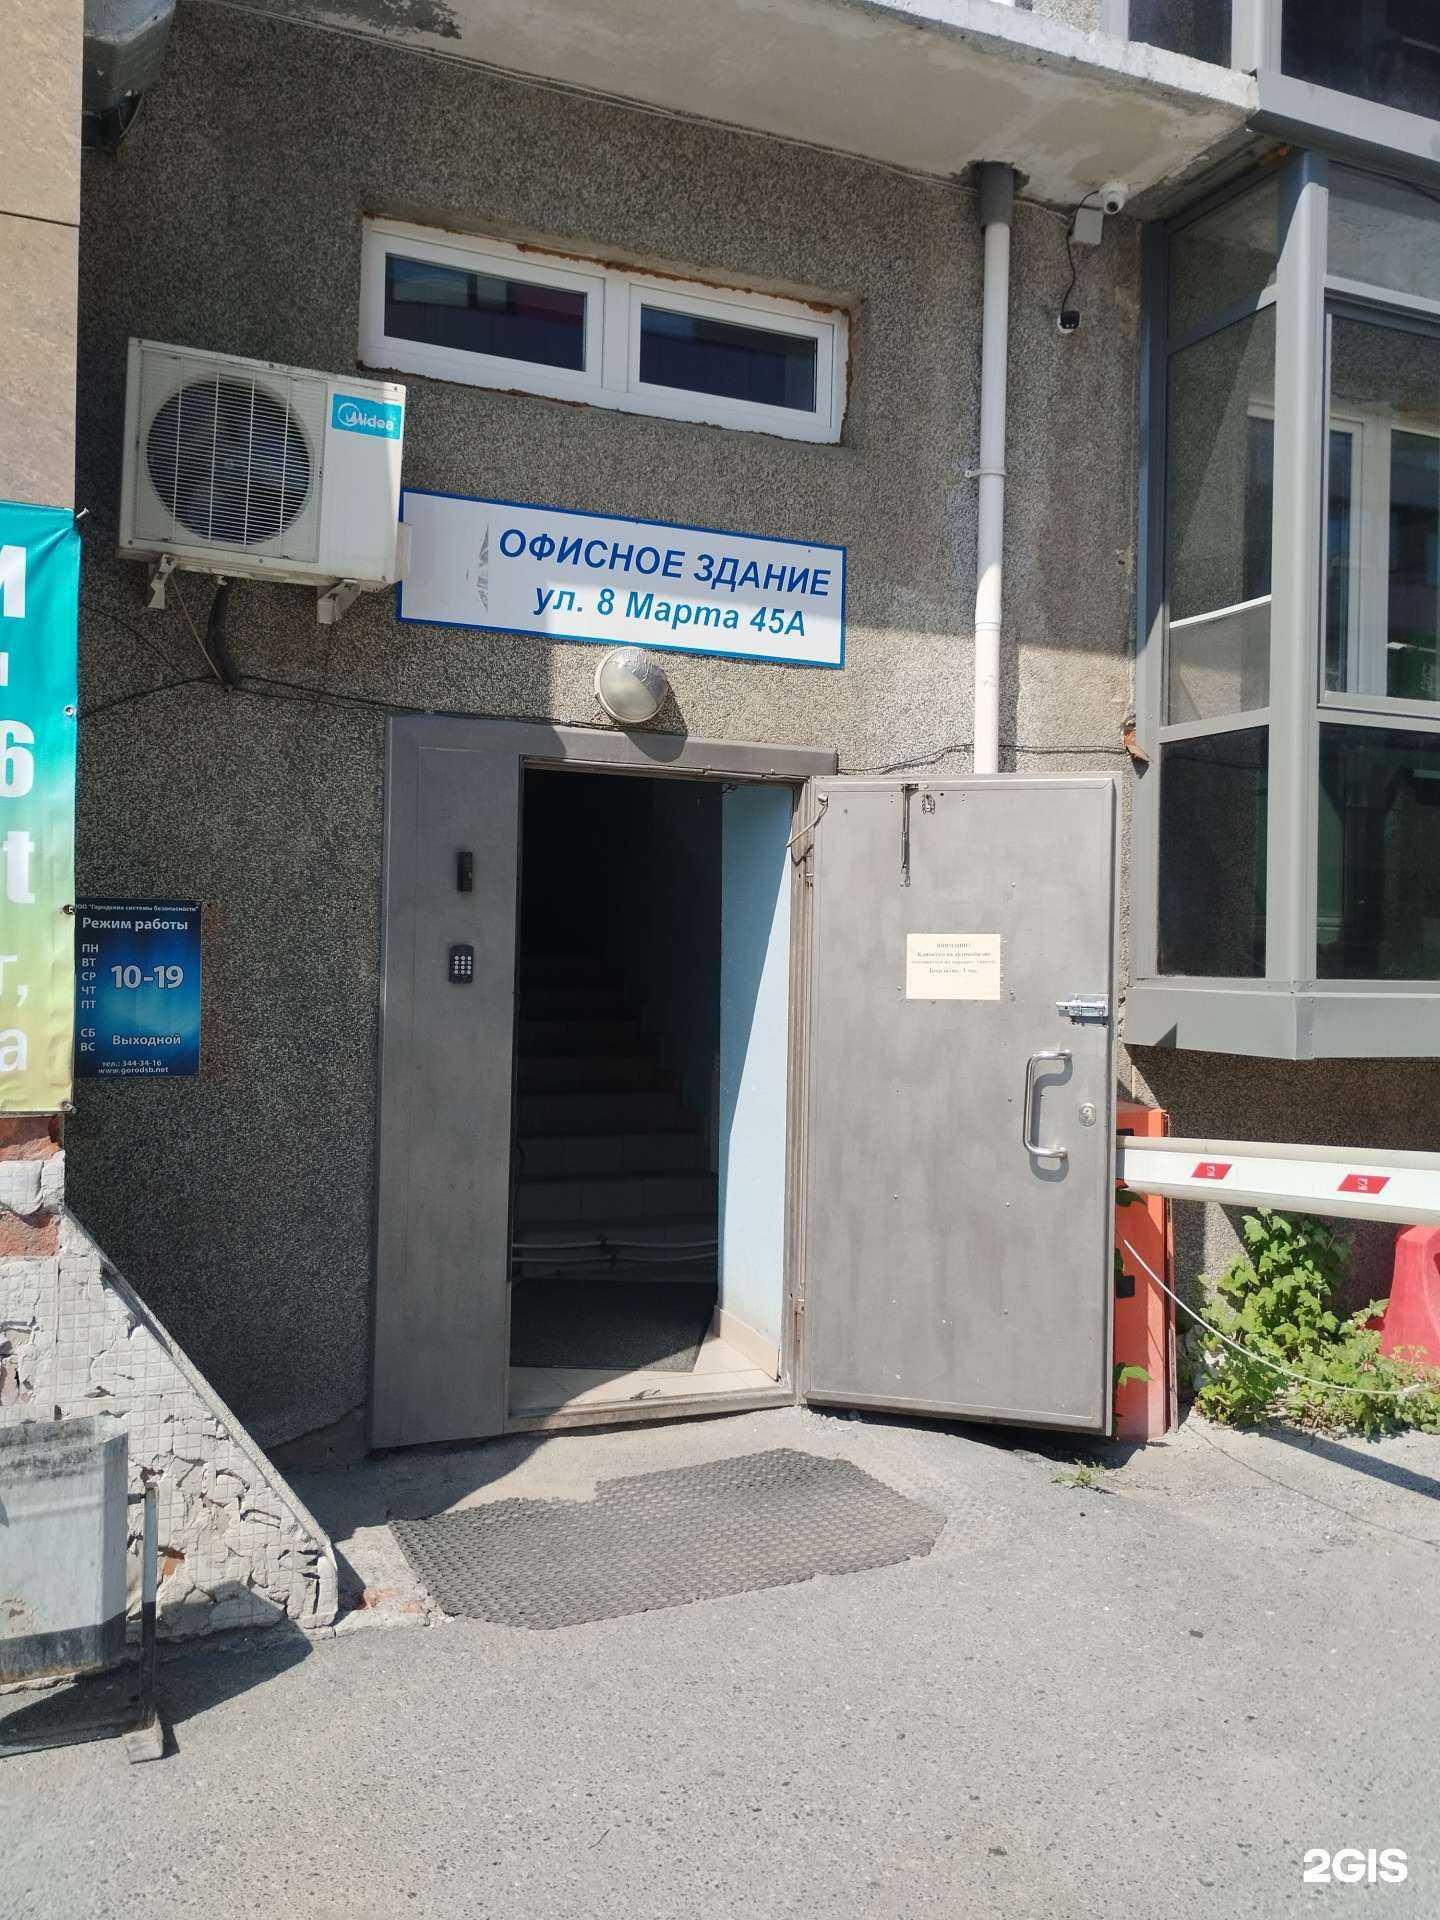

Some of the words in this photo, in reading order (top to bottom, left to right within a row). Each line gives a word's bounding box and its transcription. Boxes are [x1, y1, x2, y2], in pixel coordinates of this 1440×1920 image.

[342, 407, 395, 431] Midea
[500, 528, 685, 578] ОФИСНОЕ
[693, 553, 832, 596] ЗДАНИЕ
[533, 588, 583, 615] ул.
[597, 588, 615, 615] 8
[625, 591, 740, 630] Марта
[750, 606, 805, 636] 45А
[82, 917, 131, 929] Режим
[134, 918, 188, 932] работы
[82, 943, 99, 953] ПН
[82, 957, 97, 967] ВТ
[81, 971, 97, 981] СР
[111, 965, 184, 989] 10-19
[81, 986, 97, 995] ЧТ
[81, 1000, 97, 1009] ПТ
[80, 1028, 96, 1037] СБ
[112, 1034, 181, 1046] Выходной
[80, 1042, 96, 1051] ВС
